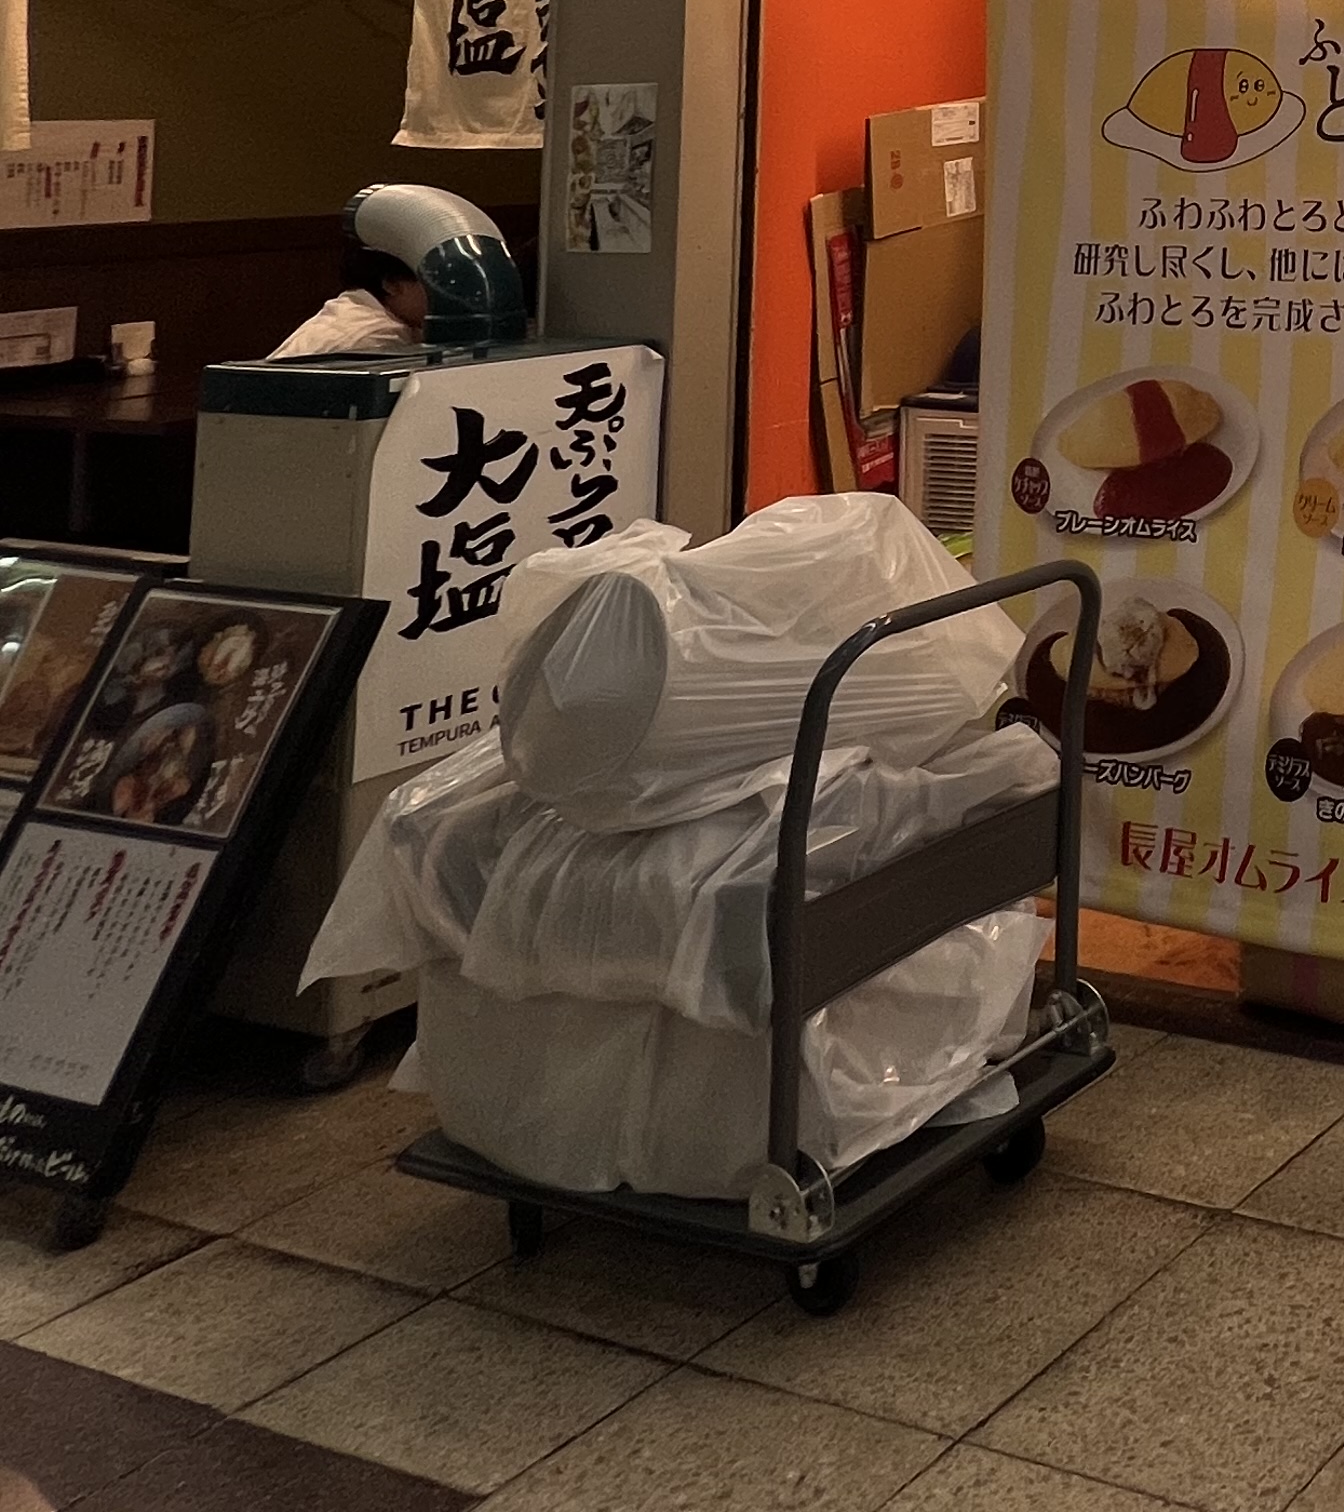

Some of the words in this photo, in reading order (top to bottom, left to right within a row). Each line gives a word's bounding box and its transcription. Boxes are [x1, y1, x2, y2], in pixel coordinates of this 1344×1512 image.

[398, 406, 539, 641] 大塩
[399, 689, 480, 732] THE
[396, 719, 482, 758] TEMPURA
[1083, 760, 1192, 794] ーズハンバーグ
